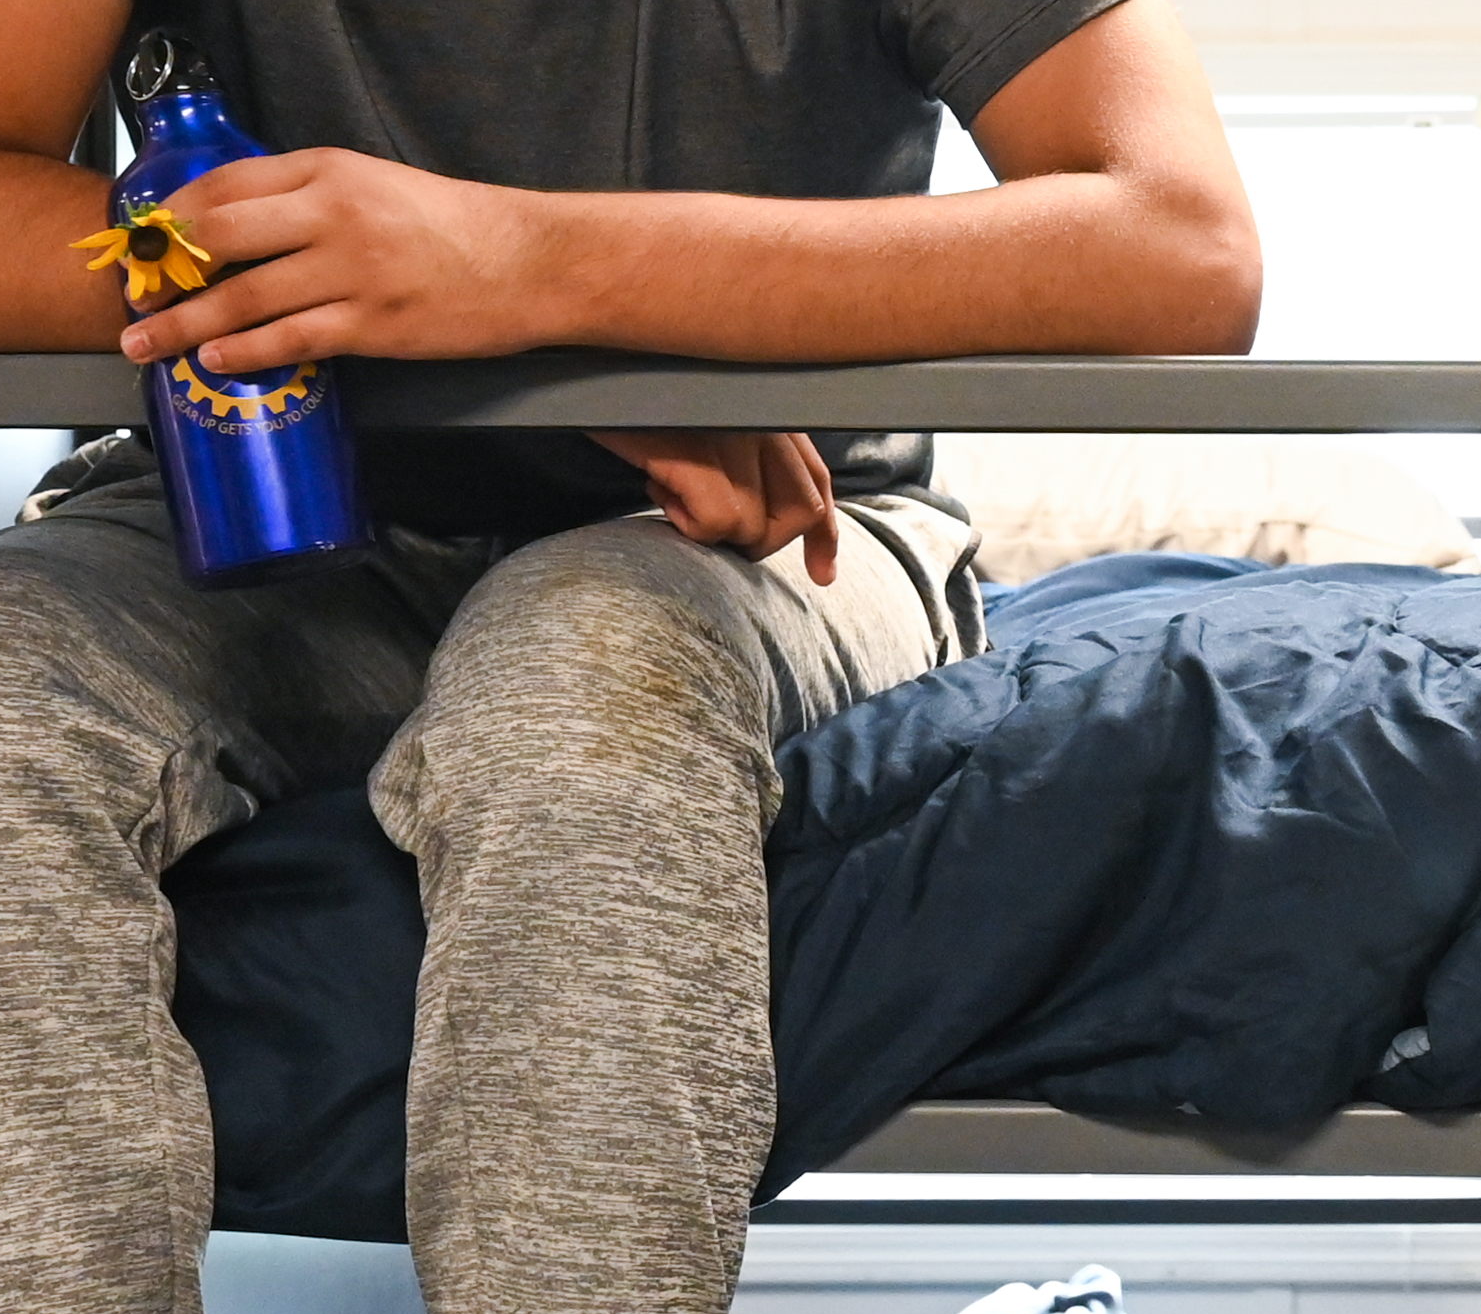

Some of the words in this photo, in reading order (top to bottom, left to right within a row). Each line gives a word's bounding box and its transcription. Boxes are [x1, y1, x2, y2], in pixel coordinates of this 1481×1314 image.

[172, 394, 199, 422] GEAR
[199, 416, 216, 430] UP
[218, 422, 252, 435] GETS
[254, 419, 284, 433] YOU
[284, 410, 301, 425] TO
